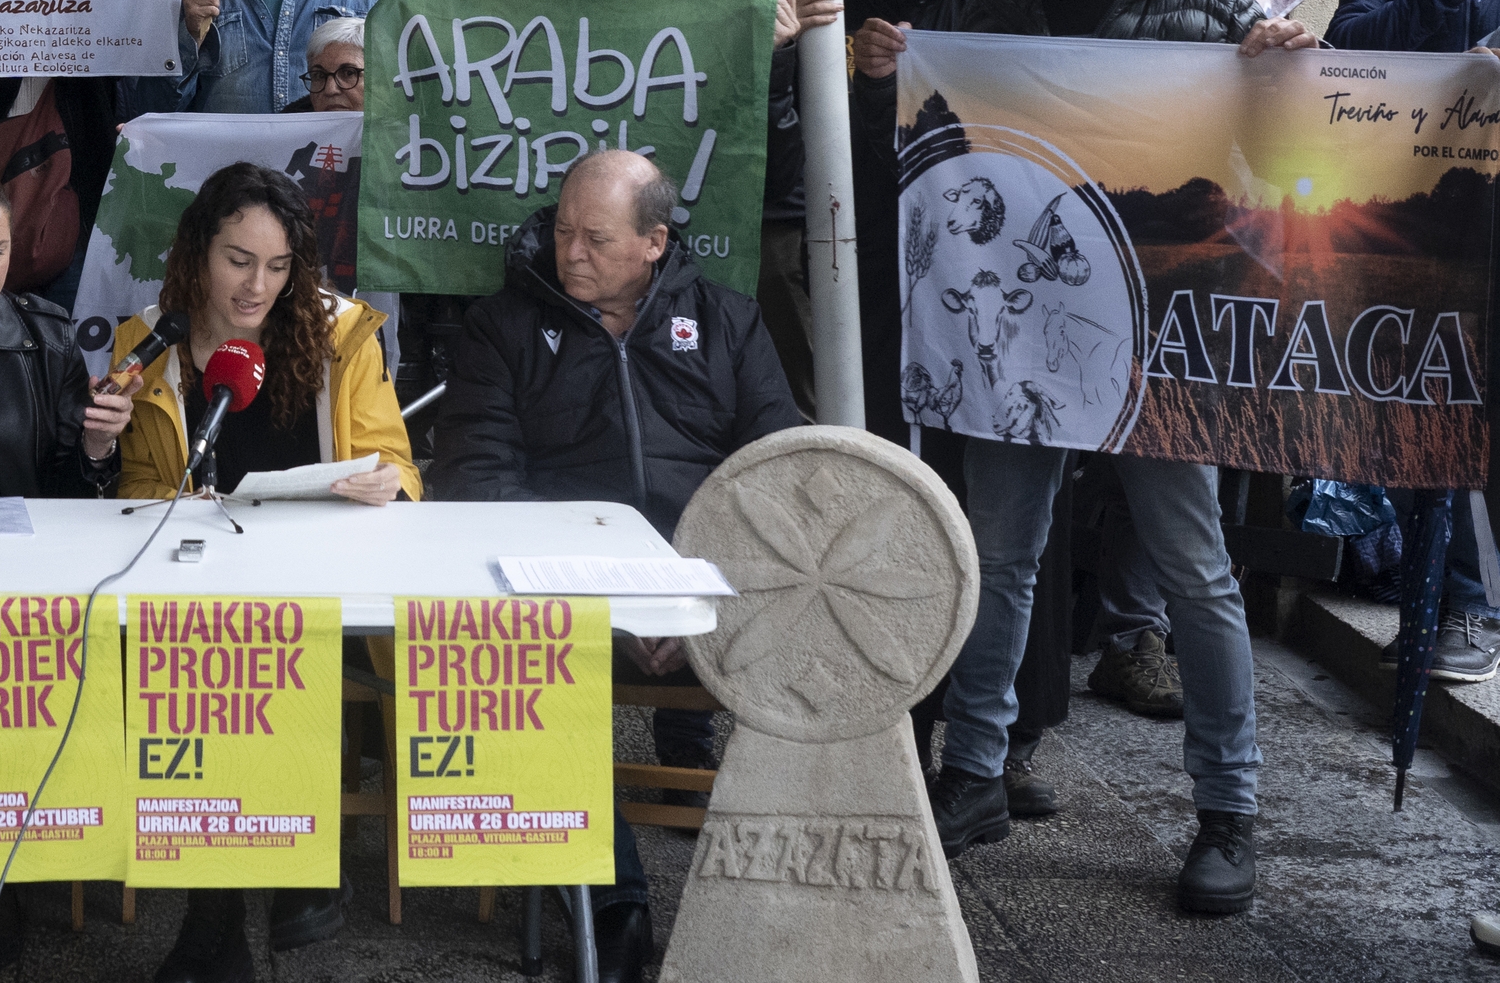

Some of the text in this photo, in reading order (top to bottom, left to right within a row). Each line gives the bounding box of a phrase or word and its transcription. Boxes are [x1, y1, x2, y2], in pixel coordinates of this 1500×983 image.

[19, 24, 91, 36] Nekazaritza
[51, 36, 92, 47] aldeko
[96, 36, 143, 47] elkartea
[31, 51, 77, 61] Alavesa
[81, 51, 96, 60] de
[34, 62, 90, 74] Ecológica
[1319, 66, 1387, 80] ASOCIACIÓN
[1324, 91, 1398, 125] Treviño
[1411, 107, 1428, 134] y
[1413, 145, 1499, 161] POR EL CAMPO
[384, 216, 458, 241] LURRA
[1147, 289, 1482, 405] ATACA
[139, 600, 304, 644] MAKRO
[407, 598, 572, 641] MAKRO
[139, 646, 305, 690] PROIEK
[407, 643, 576, 687] PROIEK
[139, 692, 274, 735] TURIK
[409, 688, 545, 732] TURIK
[139, 737, 204, 780] EZ!
[409, 735, 475, 778] EZ!
[137, 799, 239, 813] MANIFESTAZIOA
[410, 796, 511, 810] MANIFESTAZIOA
[22, 808, 99, 827] OCTUBRE
[138, 816, 311, 834] URRIAK 26 OCTUBRE
[411, 812, 585, 830] URRIAK 26 OCTUBRE
[137, 836, 170, 847] PLAZA
[411, 833, 442, 844] PLAZA
[139, 849, 177, 860] 18:00 H
[411, 846, 449, 858] 18:00 H
